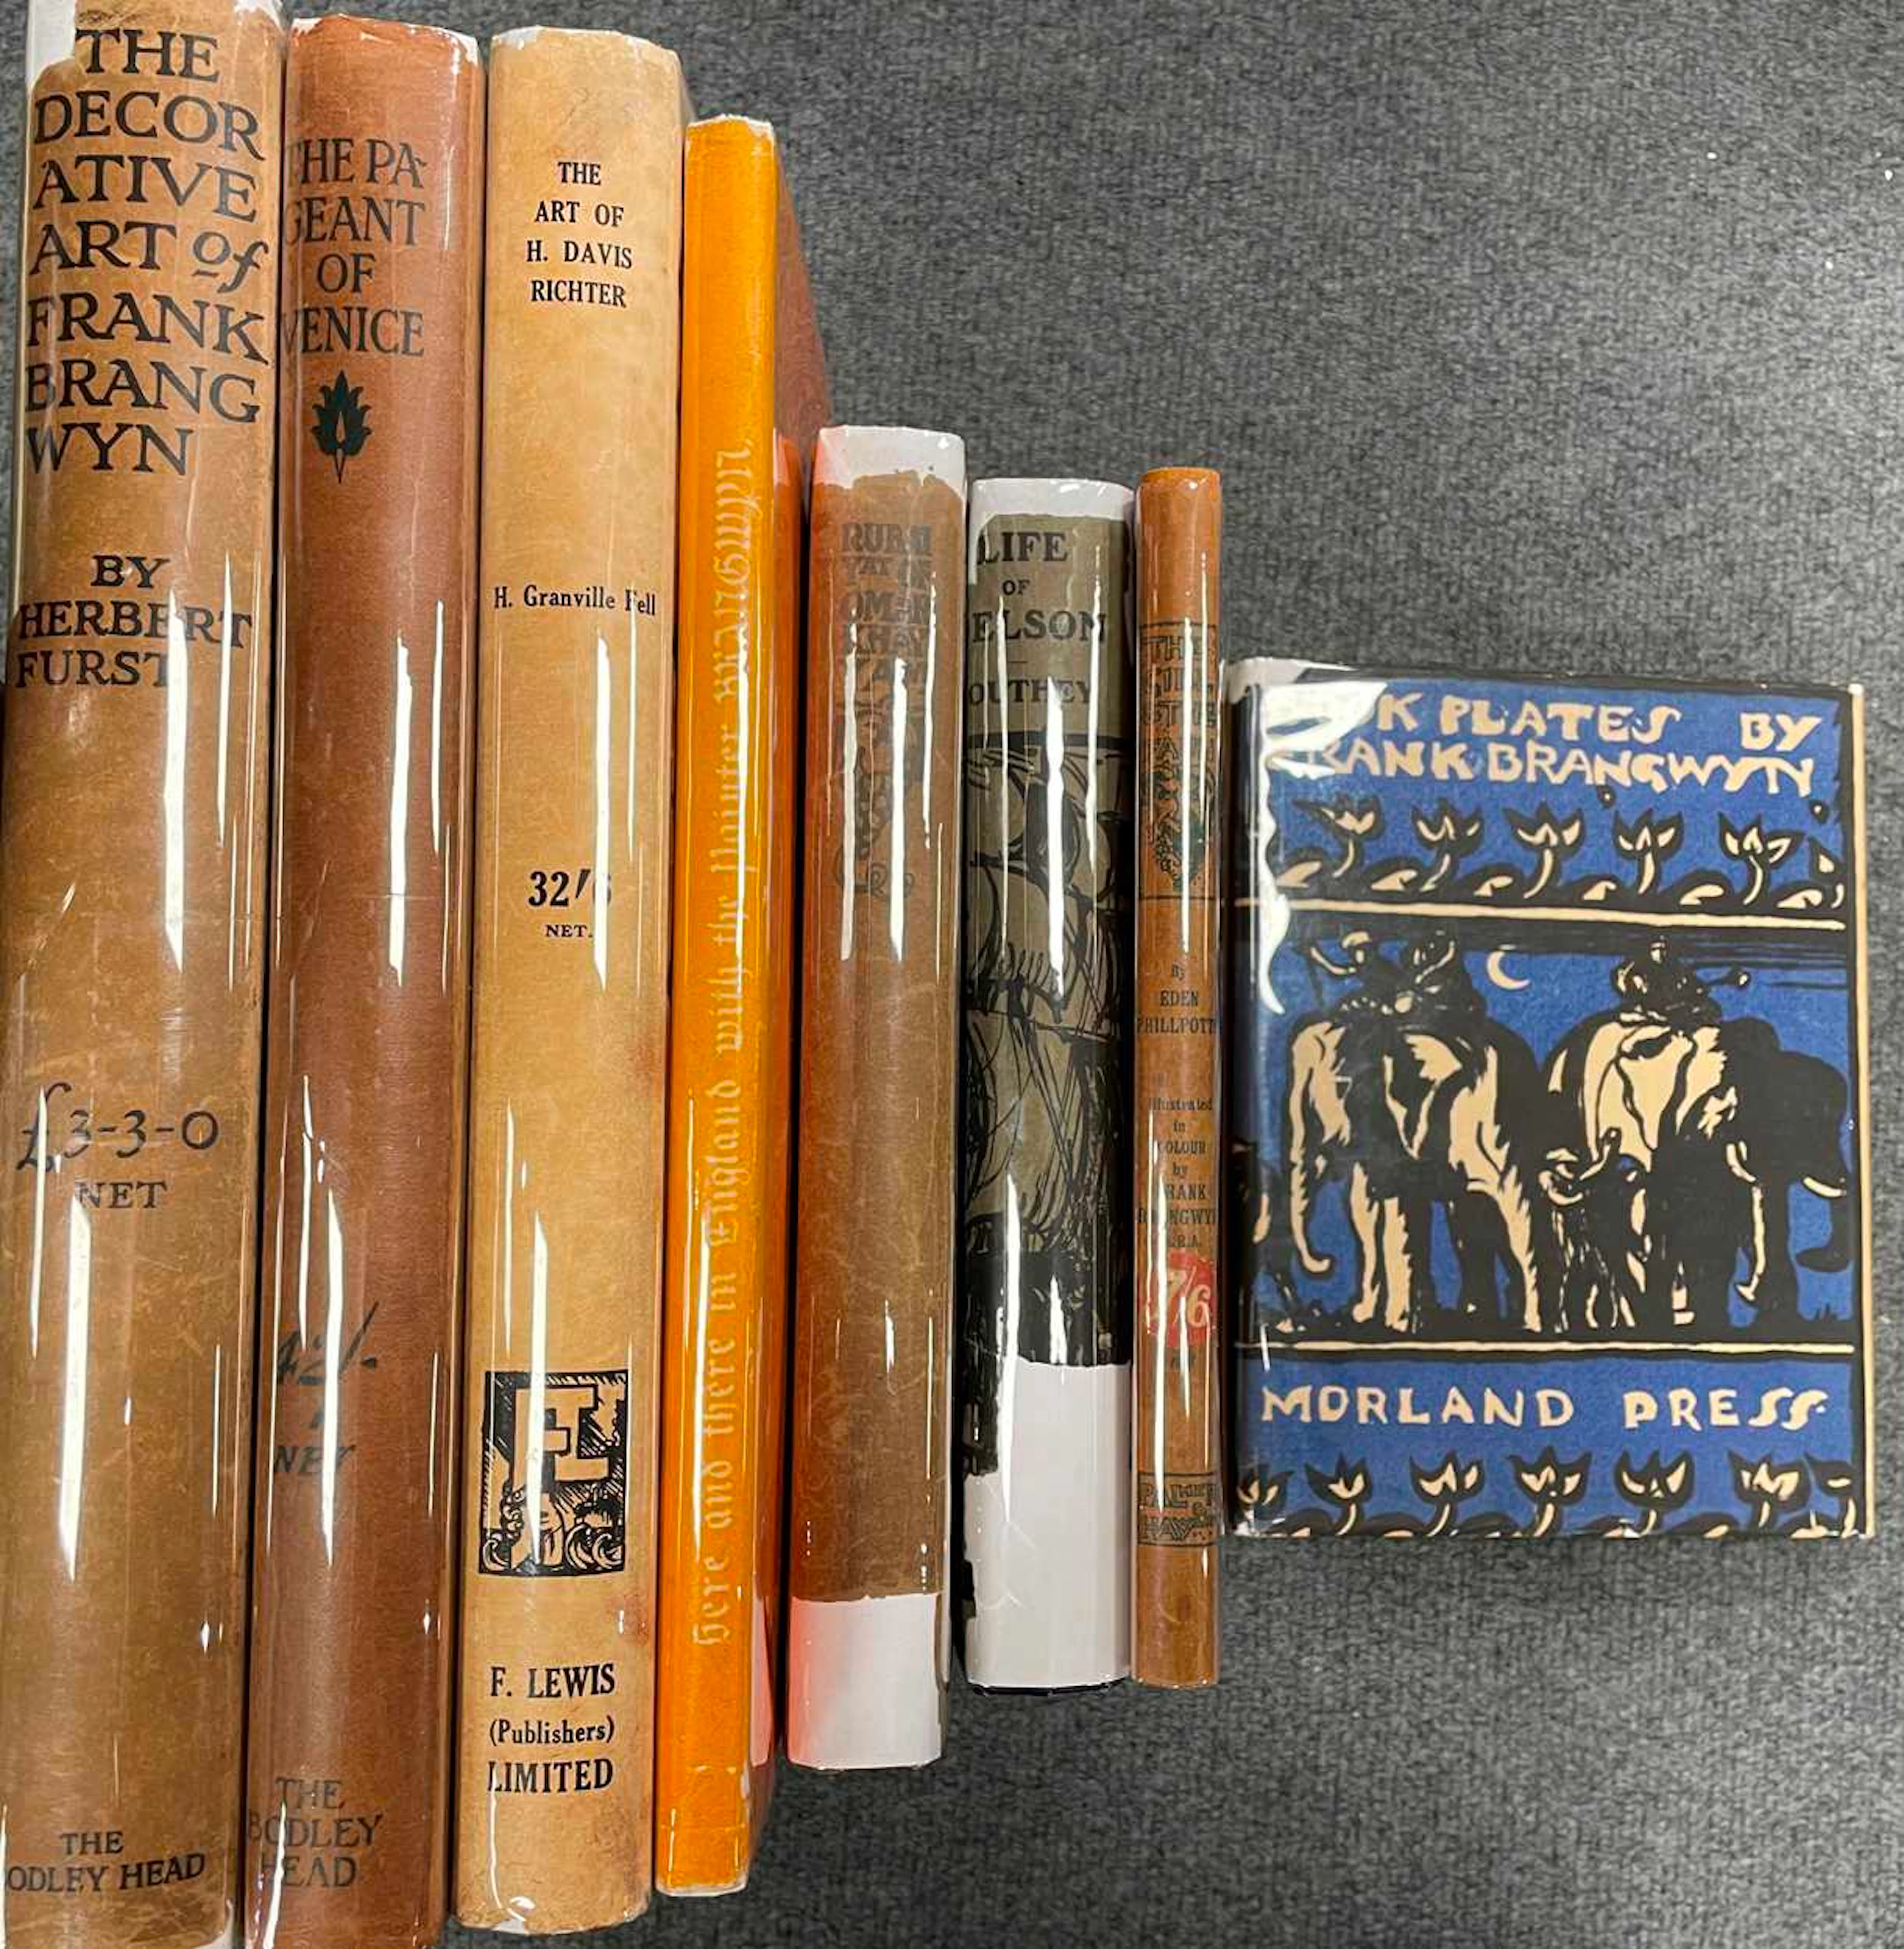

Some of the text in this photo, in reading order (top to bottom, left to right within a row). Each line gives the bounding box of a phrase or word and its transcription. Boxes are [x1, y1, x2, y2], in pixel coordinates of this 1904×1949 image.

[75, 28, 220, 83] THE
[34, 91, 266, 161] DECOR
[33, 156, 257, 223] ATIVE
[558, 161, 601, 185] THE
[285, 196, 425, 246] GEANT
[535, 200, 624, 227] ART OF
[29, 220, 269, 294] ART of
[317, 252, 375, 294] OF
[526, 239, 632, 269] H. DAVIS
[531, 280, 627, 308] RICHTER
[27, 292, 269, 365] FRANK
[282, 306, 425, 356] VENICE
[25, 358, 260, 423] BRANG
[24, 423, 194, 476] WYN
[977, 531, 1068, 565] LIFE
[91, 554, 171, 589] BY
[1002, 579, 1030, 595] OF
[494, 584, 655, 616] H. Granville Fell
[20, 600, 252, 648] HERBERT
[972, 610, 1106, 643] ELSON
[16, 650, 170, 688] FURST
[968, 676, 1091, 706] OUTHEY
[1440, 696, 1681, 745] PLATES
[1739, 711, 1822, 752] BY
[1309, 735, 1814, 797] RANK BRANGWYN
[546, 924, 594, 937] NET.
[704, 895, 748, 946] the
[708, 966, 753, 1055] with
[1161, 991, 1198, 1006] EDEN
[1137, 1018, 1216, 1034] PHILLPOTT
[1174, 1120, 1185, 1132] in
[703, 1079, 749, 1247] England
[1173, 1162, 1188, 1175] by
[74, 1181, 168, 1209] NET
[1159, 1184, 1205, 1199] RANK
[710, 1272, 737, 1311] in
[704, 1338, 737, 1436] there
[1261, 1384, 1828, 1431] MORLAND PRESS
[704, 1460, 733, 1530] and
[692, 1556, 731, 1646] Here
[491, 1663, 616, 1698] F. LEWIS
[489, 1715, 615, 1746] (Publishers)
[275, 1776, 345, 1809] THE
[488, 1759, 614, 1793] LIMITED
[60, 1831, 123, 1855] THE
[249, 1809, 383, 1847] BODLEY
[6, 1854, 205, 1892] ODLEY HEAD
